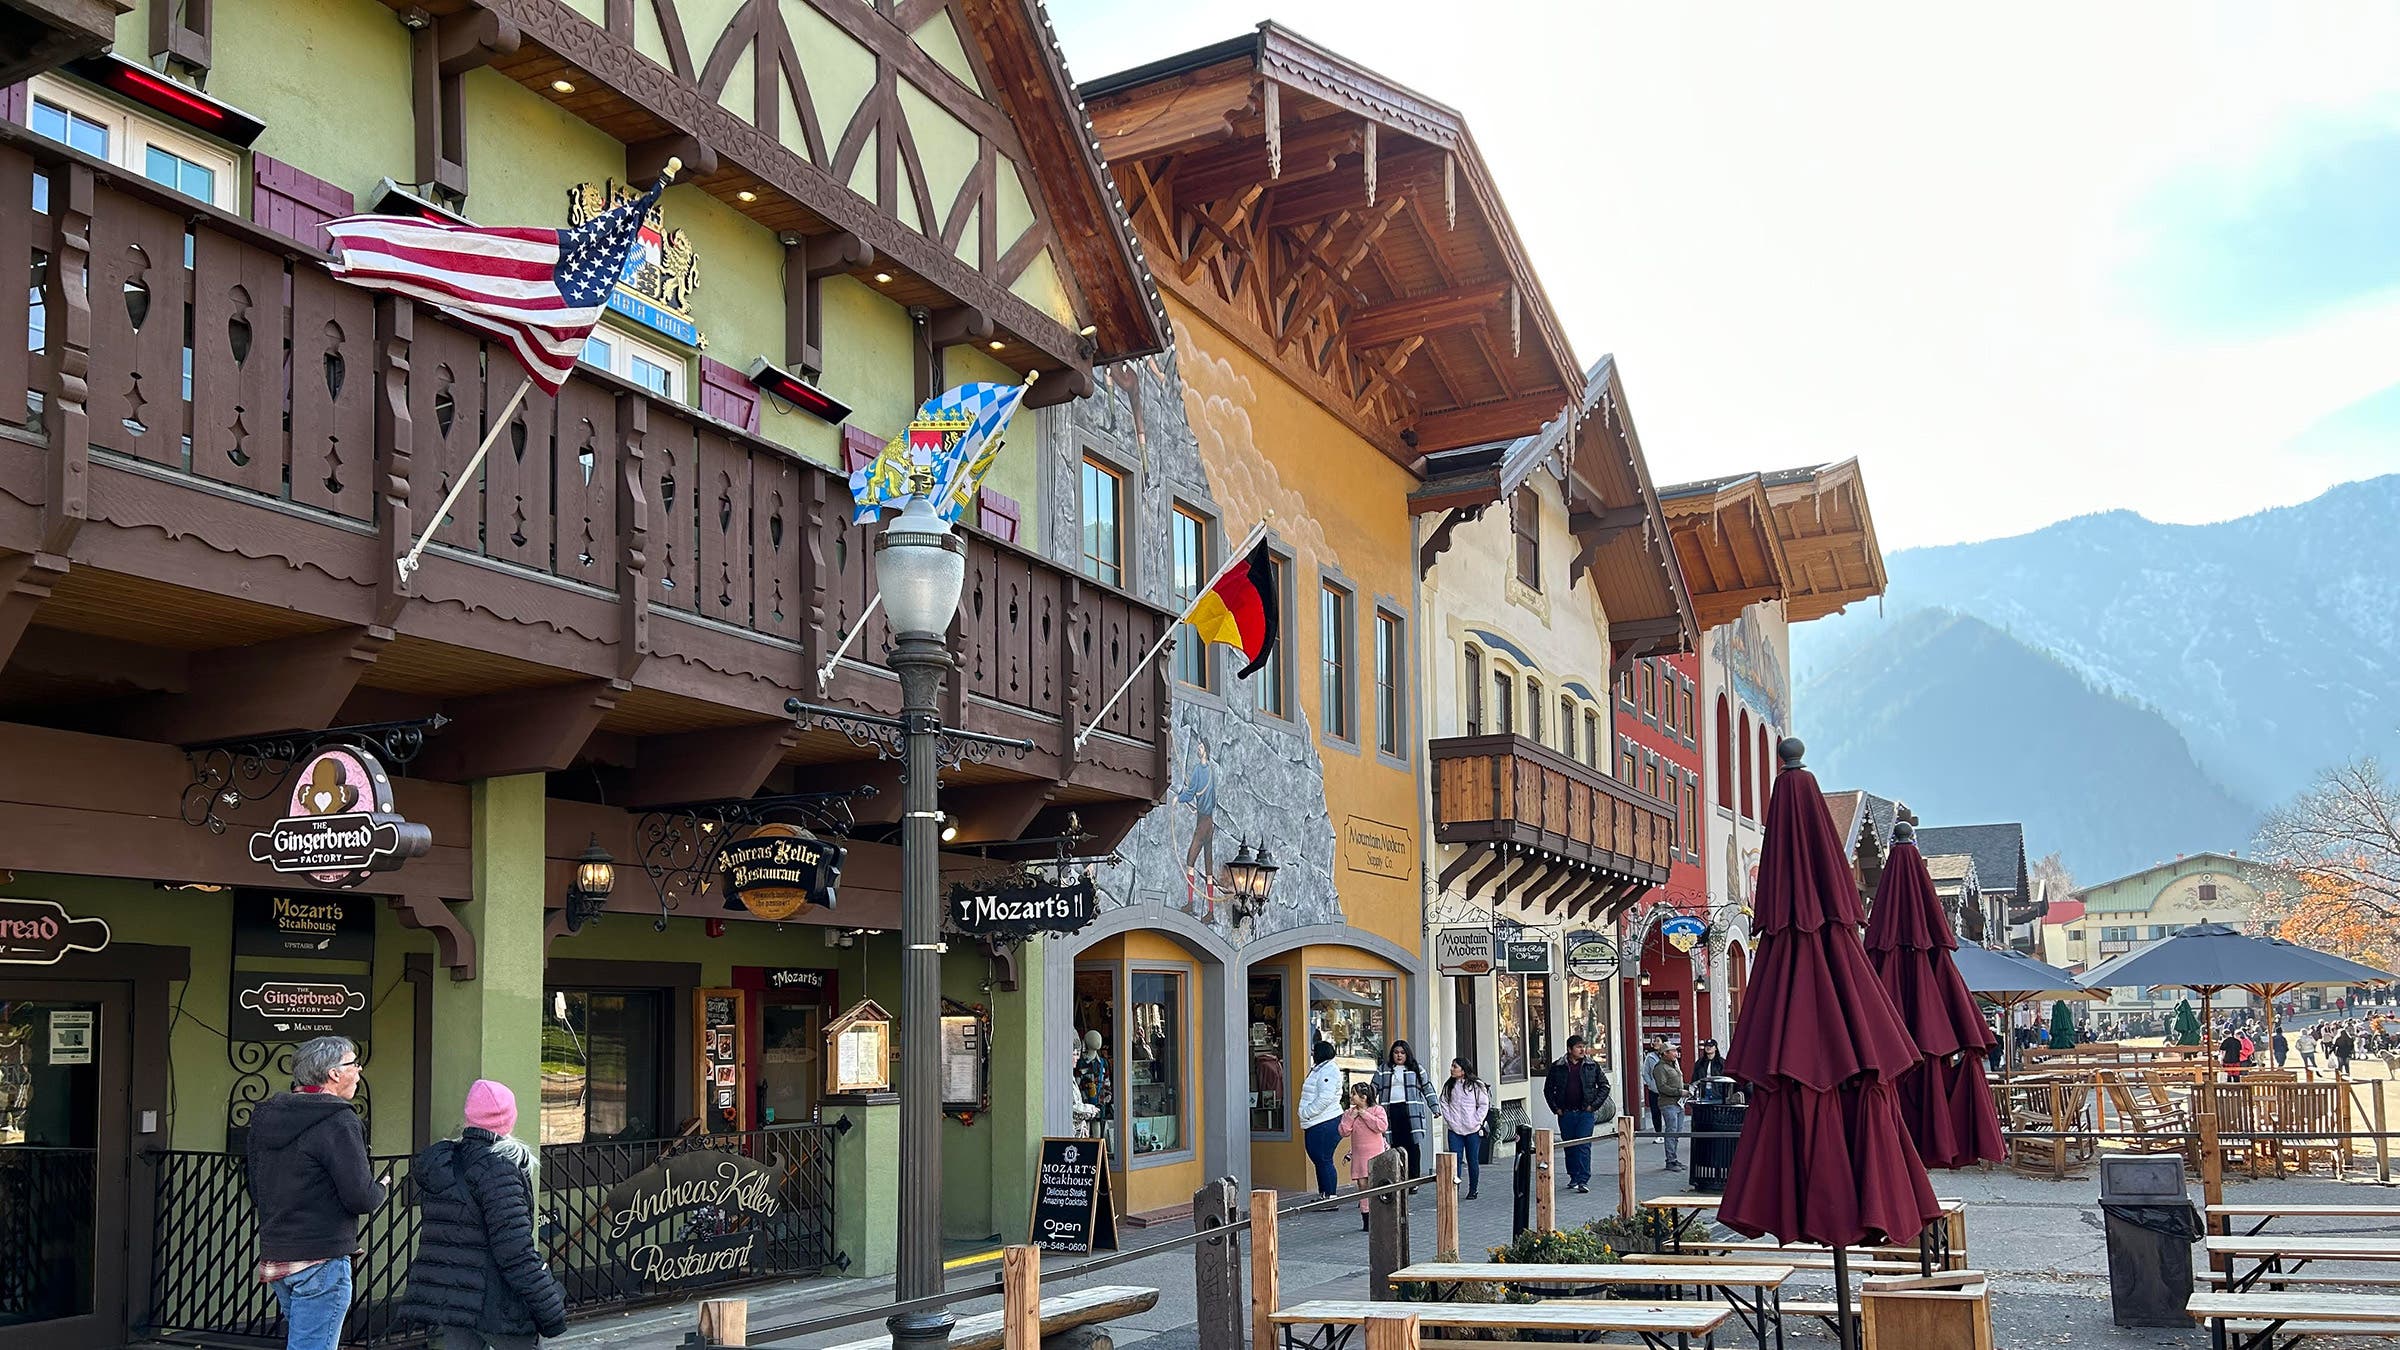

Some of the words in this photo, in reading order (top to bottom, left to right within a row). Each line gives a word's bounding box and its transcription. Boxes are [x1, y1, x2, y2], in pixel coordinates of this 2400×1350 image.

[312, 822, 327, 830] THE
[274, 826, 371, 854] Gingerbread
[1348, 826, 1381, 849] Mountain
[1380, 834, 1406, 854] Modern
[300, 854, 342, 864] FACTORY
[774, 840, 820, 866] Keller
[1367, 851, 1383, 870] Supply
[733, 866, 801, 887] Restaurant
[272, 898, 343, 920] Mozart's
[975, 893, 1070, 927] Mozart's
[279, 918, 336, 931] Steakhouse
[1441, 933, 1488, 945] Mountain
[1447, 944, 1488, 957] Modern
[777, 970, 818, 987] Mozart's
[263, 990, 344, 1006] Gingerbread
[1042, 1163, 1097, 1174] MOZART'S
[1042, 1173, 1093, 1186] Steakhouse
[612, 1168, 719, 1238] Andreas
[716, 1162, 780, 1217] Keller
[1046, 1187, 1068, 1196] Delicious
[1069, 1188, 1087, 1197] Steaks
[1042, 1197, 1064, 1207] Amazing
[1065, 1197, 1088, 1207] Cocktails
[1043, 1219, 1081, 1232] Open
[631, 1234, 754, 1283] Restaurant
